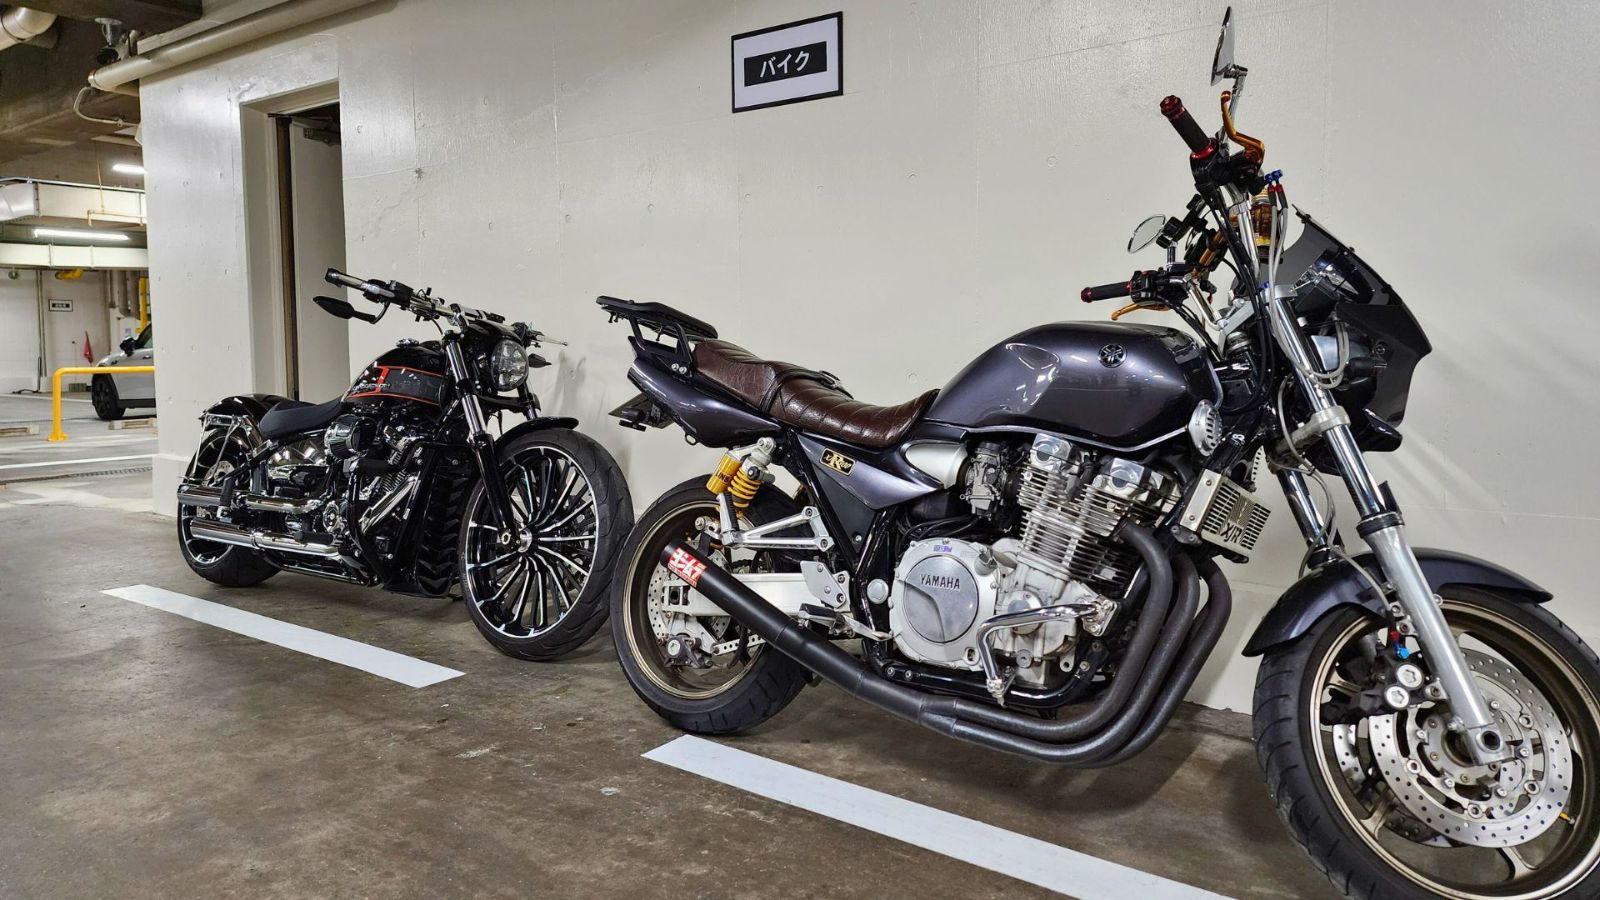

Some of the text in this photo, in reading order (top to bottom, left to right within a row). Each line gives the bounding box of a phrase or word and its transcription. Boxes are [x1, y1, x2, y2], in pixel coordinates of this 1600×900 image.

[759, 50, 810, 78] バイク
[1220, 522, 1243, 544] XJR
[920, 574, 961, 590] YAMAHA
